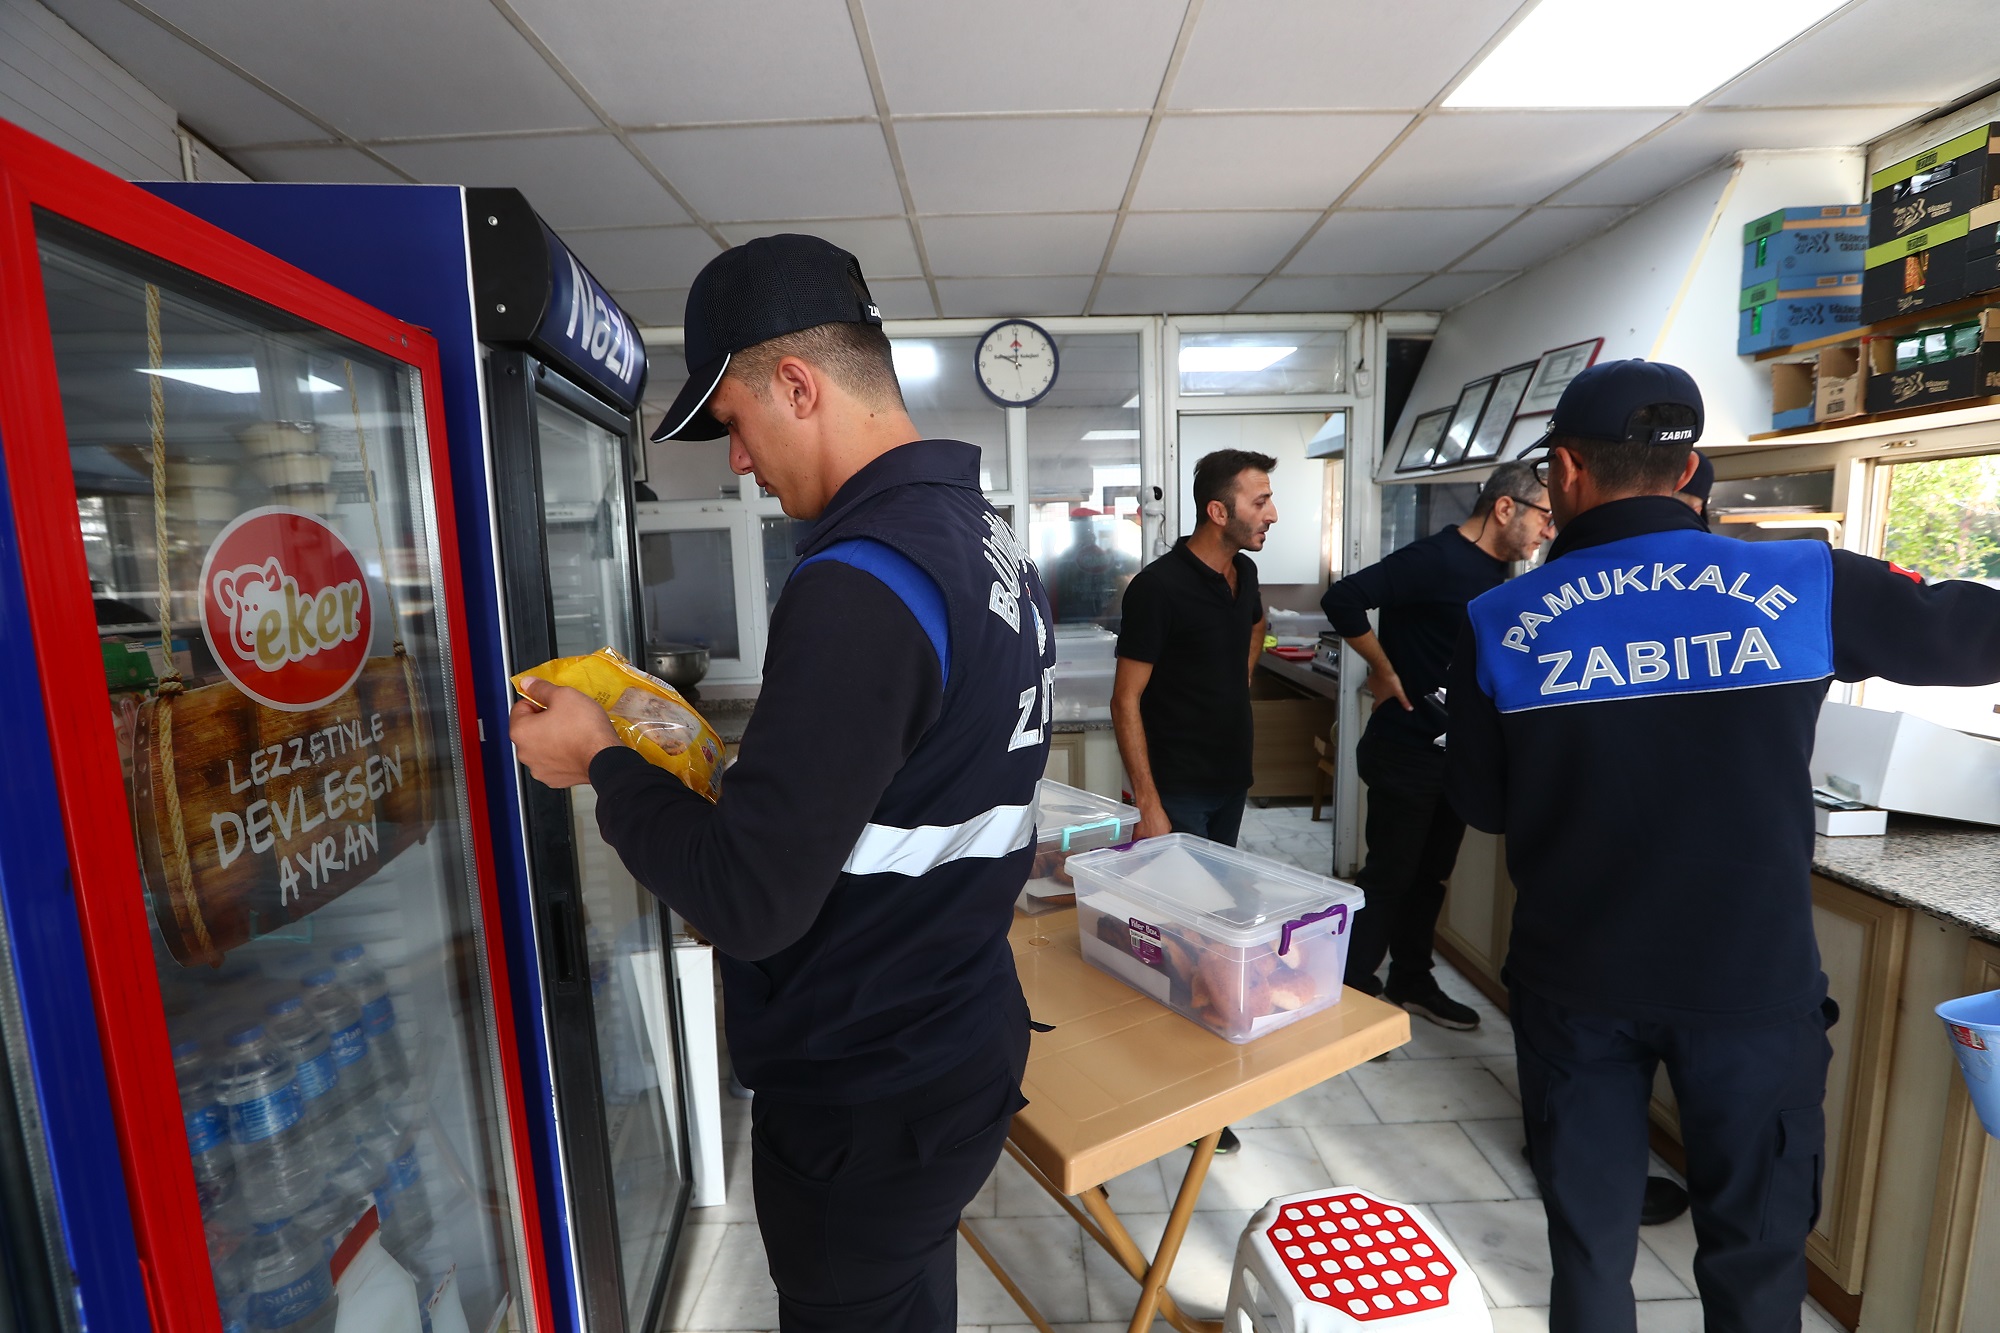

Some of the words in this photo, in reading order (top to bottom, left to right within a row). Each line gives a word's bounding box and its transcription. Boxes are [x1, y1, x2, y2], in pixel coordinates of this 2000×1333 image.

[1660, 429, 1692, 441] ZABITA
[256, 582, 360, 666] eker
[1502, 563, 1798, 653] PAMUKKALE
[1538, 627, 1781, 695] ZABITA
[227, 713, 385, 795] LEZZETİYLE
[210, 745, 403, 869] DEVLEŞEN
[280, 813, 379, 907] AYRAN
